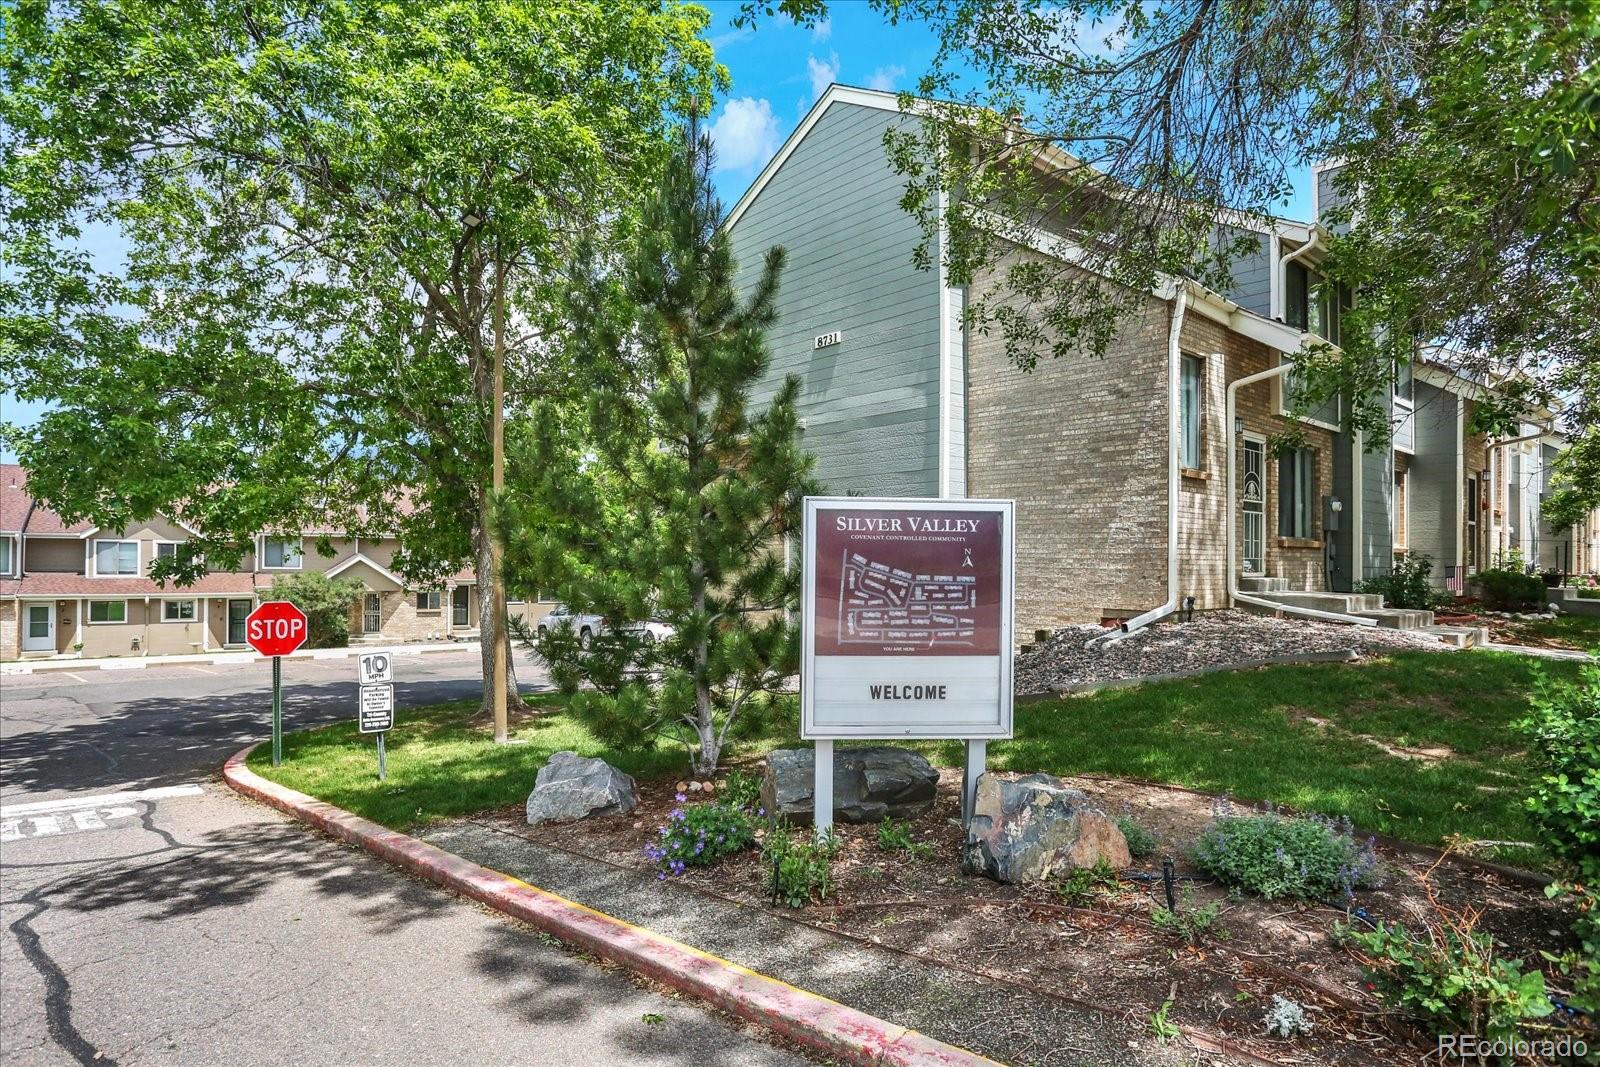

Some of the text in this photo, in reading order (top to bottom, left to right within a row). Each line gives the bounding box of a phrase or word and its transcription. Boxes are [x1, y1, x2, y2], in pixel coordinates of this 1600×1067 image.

[817, 333, 837, 347] 8731
[836, 516, 981, 533] SILVER VALLEY
[250, 619, 303, 640] STOP
[362, 655, 388, 674] 10
[870, 685, 947, 700] WELCOME
